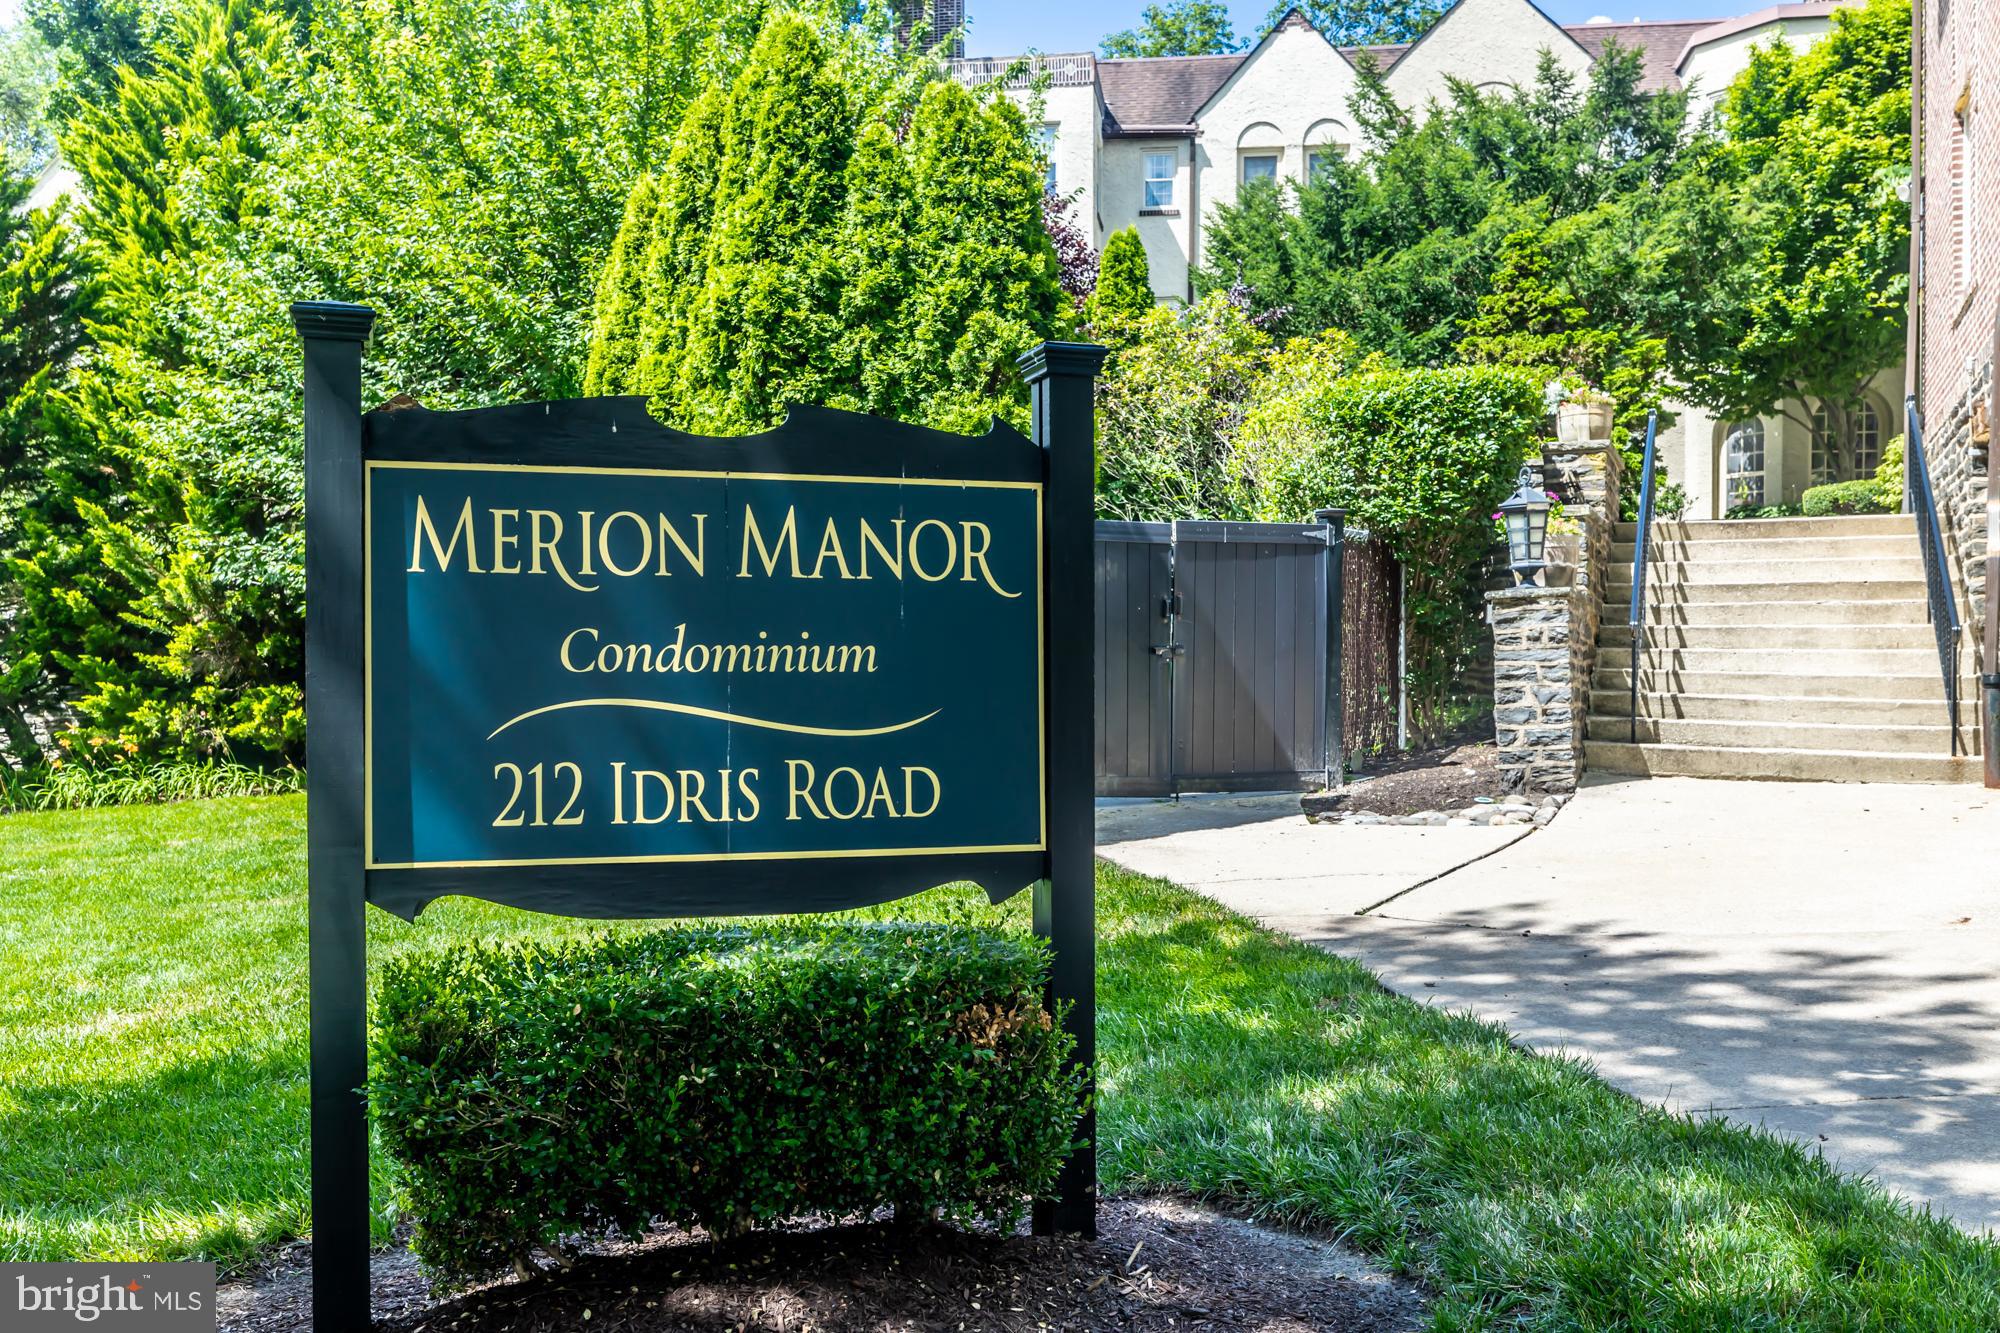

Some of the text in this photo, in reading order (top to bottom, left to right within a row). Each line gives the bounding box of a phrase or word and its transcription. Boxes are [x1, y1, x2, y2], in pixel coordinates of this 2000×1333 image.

[406, 495, 1022, 598] MERION MANOR
[560, 623, 878, 673] Condominium
[492, 759, 942, 827] 212 IDRIS ROAD
